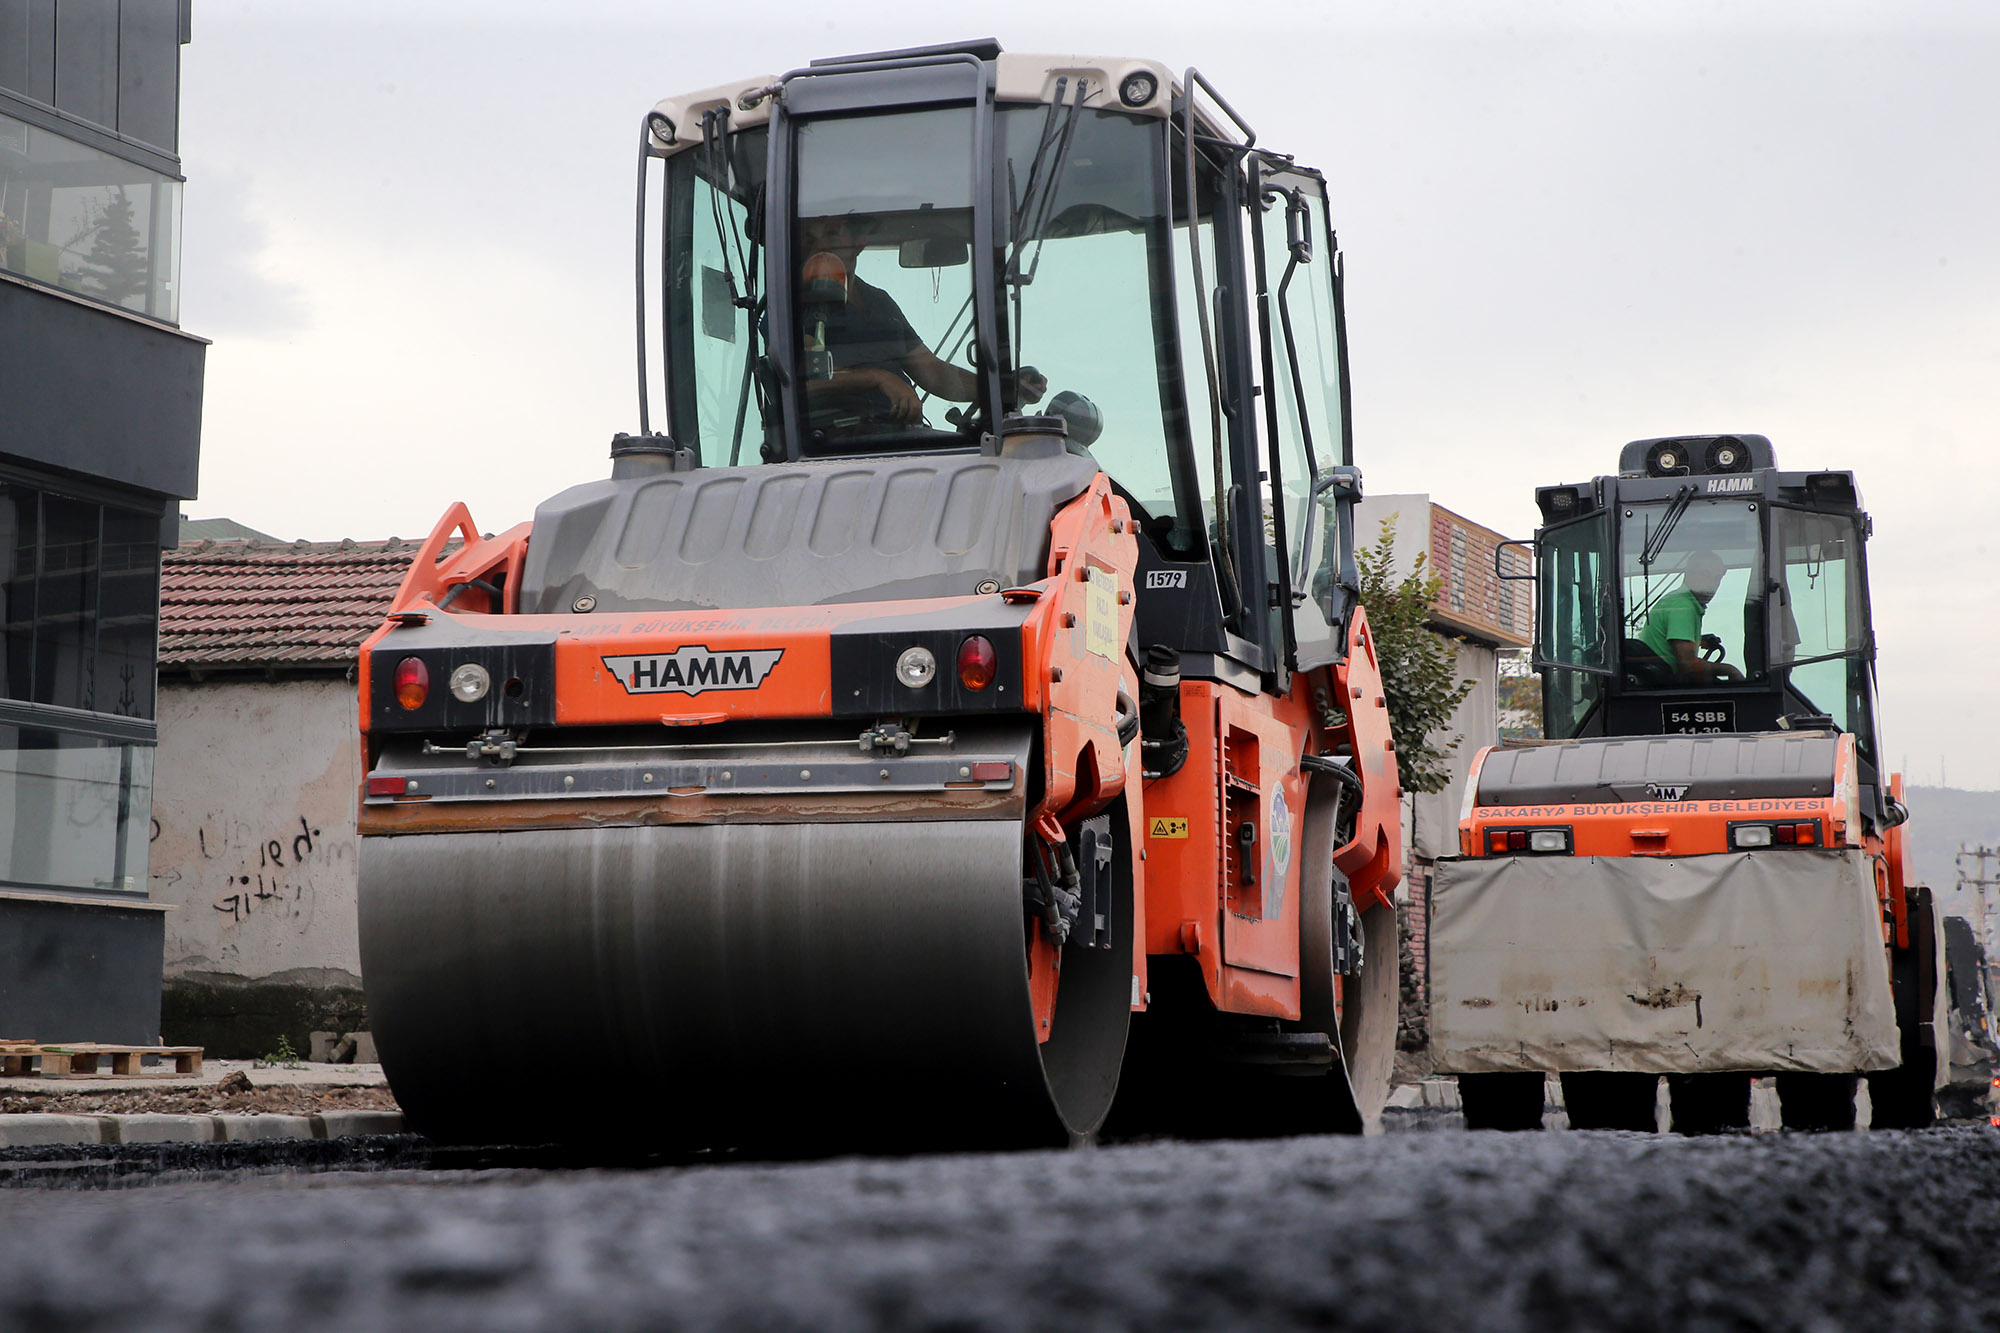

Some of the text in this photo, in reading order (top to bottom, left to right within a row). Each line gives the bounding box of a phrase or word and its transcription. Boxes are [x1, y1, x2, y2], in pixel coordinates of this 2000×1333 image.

[1706, 477, 1754, 493] HAMM
[1149, 572, 1182, 587] 1579
[633, 655, 754, 689] HAMM
[1671, 711, 1727, 723] 54 SBB
[1478, 806, 1566, 819] SAKARYA
[1573, 801, 1698, 818] BÜYÜKŞEHİR
